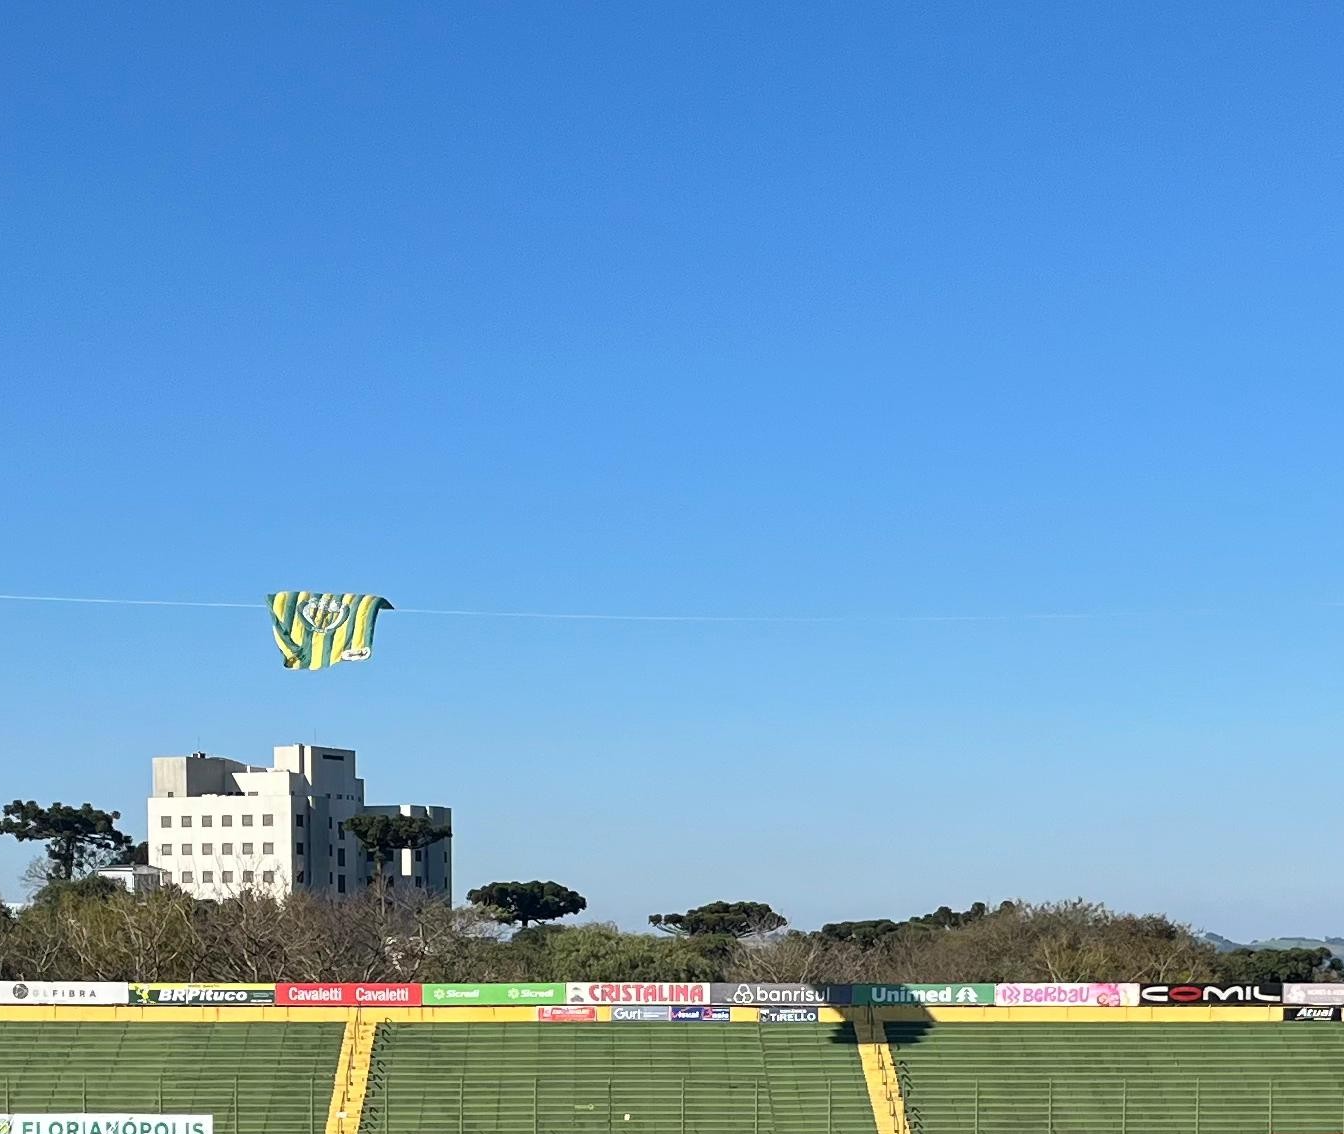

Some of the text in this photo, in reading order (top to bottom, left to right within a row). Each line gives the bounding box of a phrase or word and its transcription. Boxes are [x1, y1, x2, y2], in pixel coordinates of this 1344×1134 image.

[288, 986, 342, 1002] Cavaletti
[355, 987, 409, 1001] Cavaletti
[446, 989, 480, 998] Sicredi
[519, 989, 554, 998] Sicredi
[588, 985, 704, 1003] CRISTALINA
[756, 986, 829, 1002] banrisul
[870, 986, 952, 1003] Unimed
[1141, 986, 1281, 1001] COMIL
